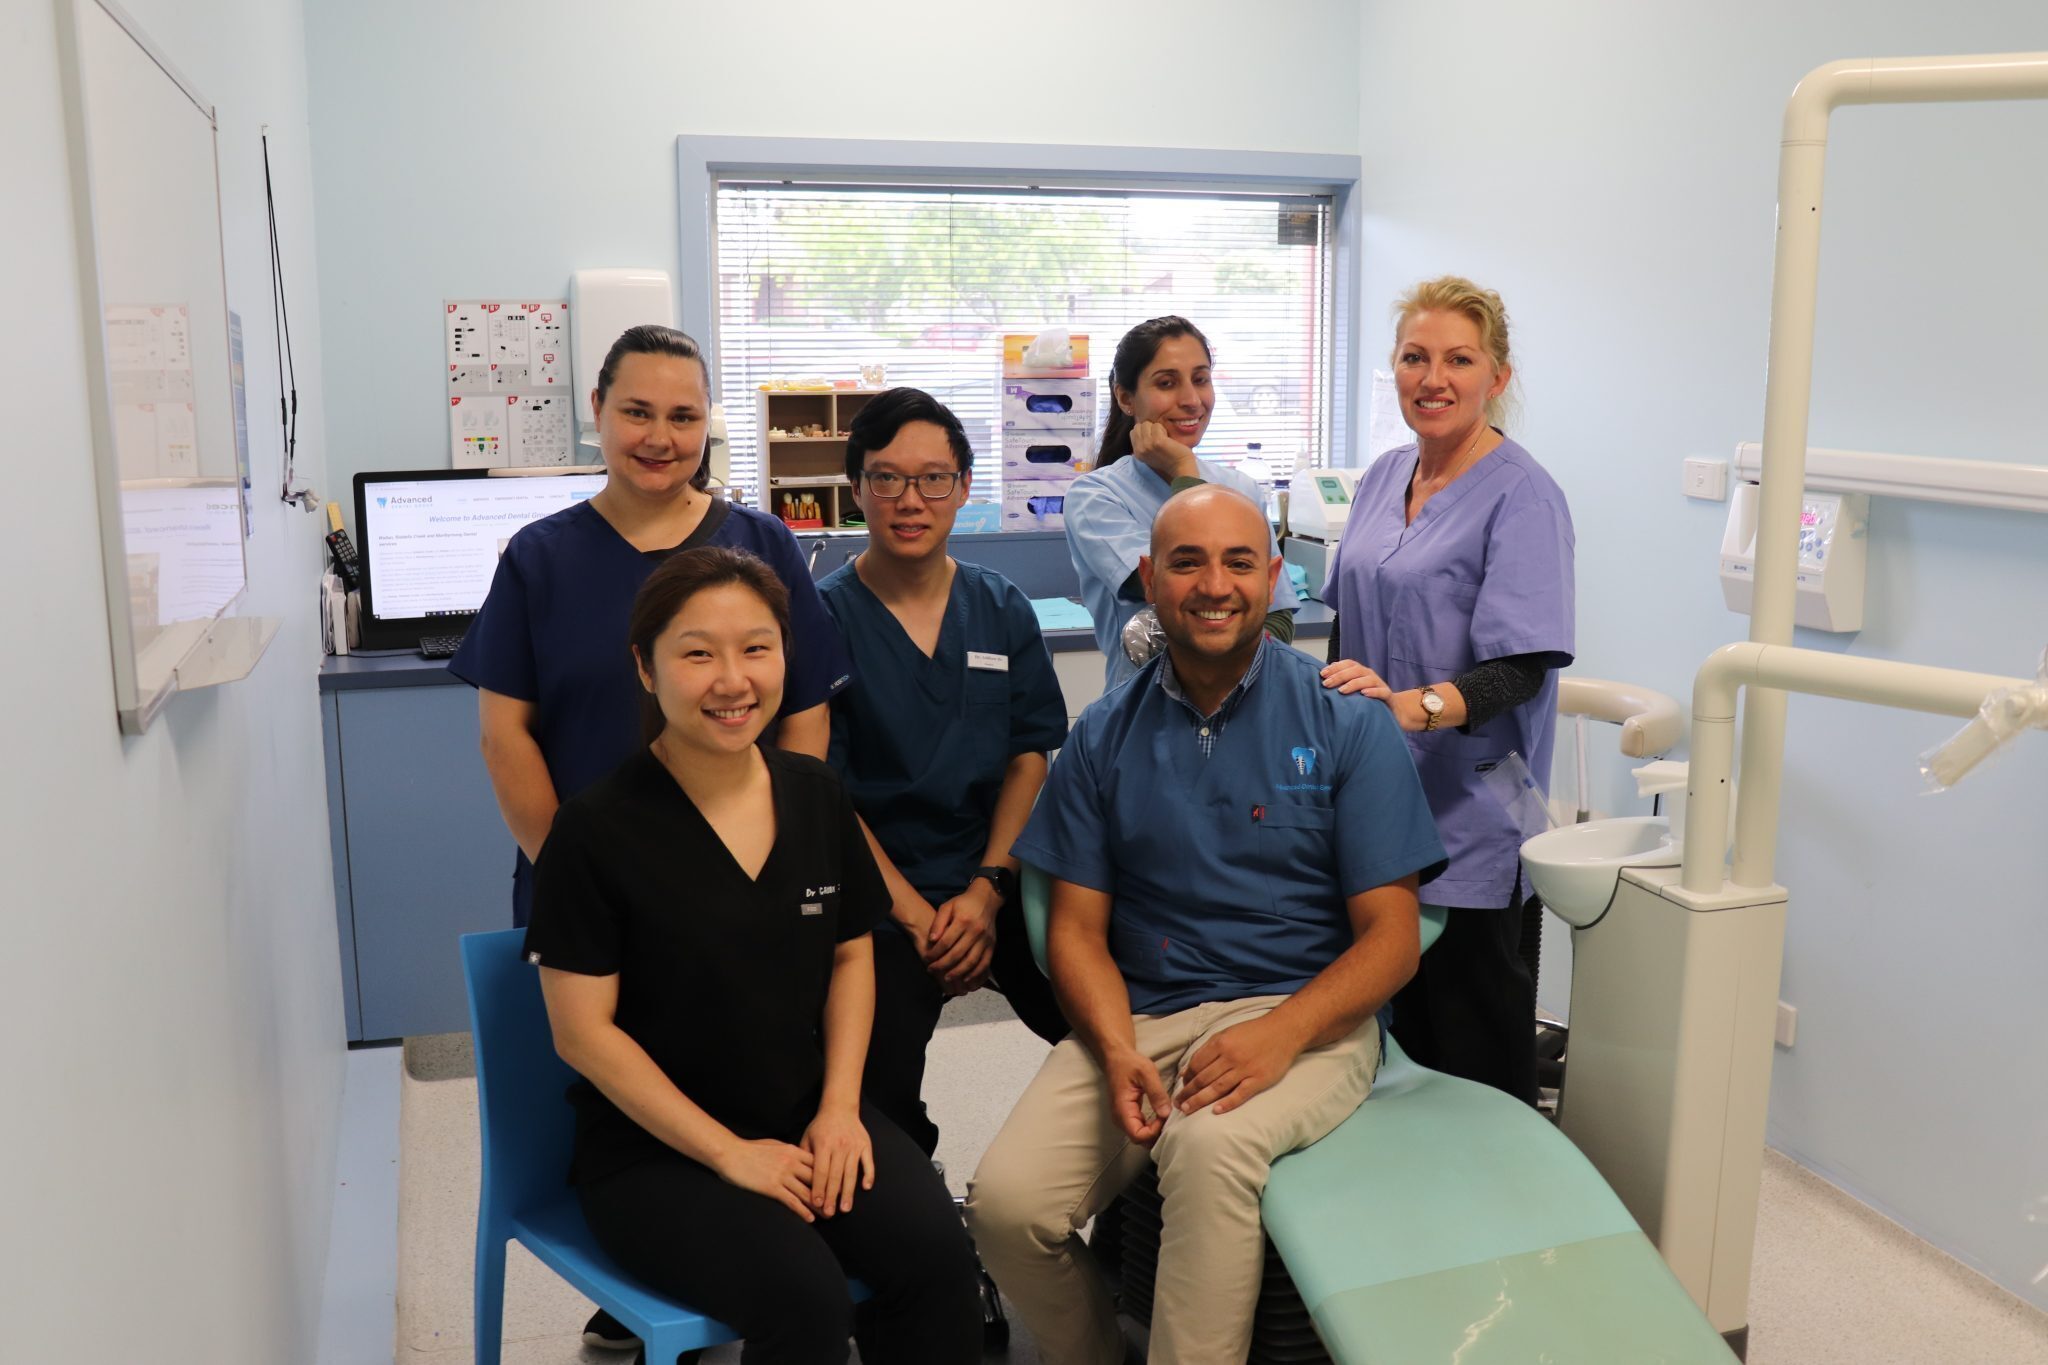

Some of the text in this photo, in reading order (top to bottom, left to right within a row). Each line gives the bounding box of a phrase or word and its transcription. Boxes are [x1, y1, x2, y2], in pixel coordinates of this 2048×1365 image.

[390, 496, 433, 504] Advanced
[472, 513, 506, 521] Advanced
[507, 511, 531, 520] Dental
[806, 888, 816, 897] Dr
